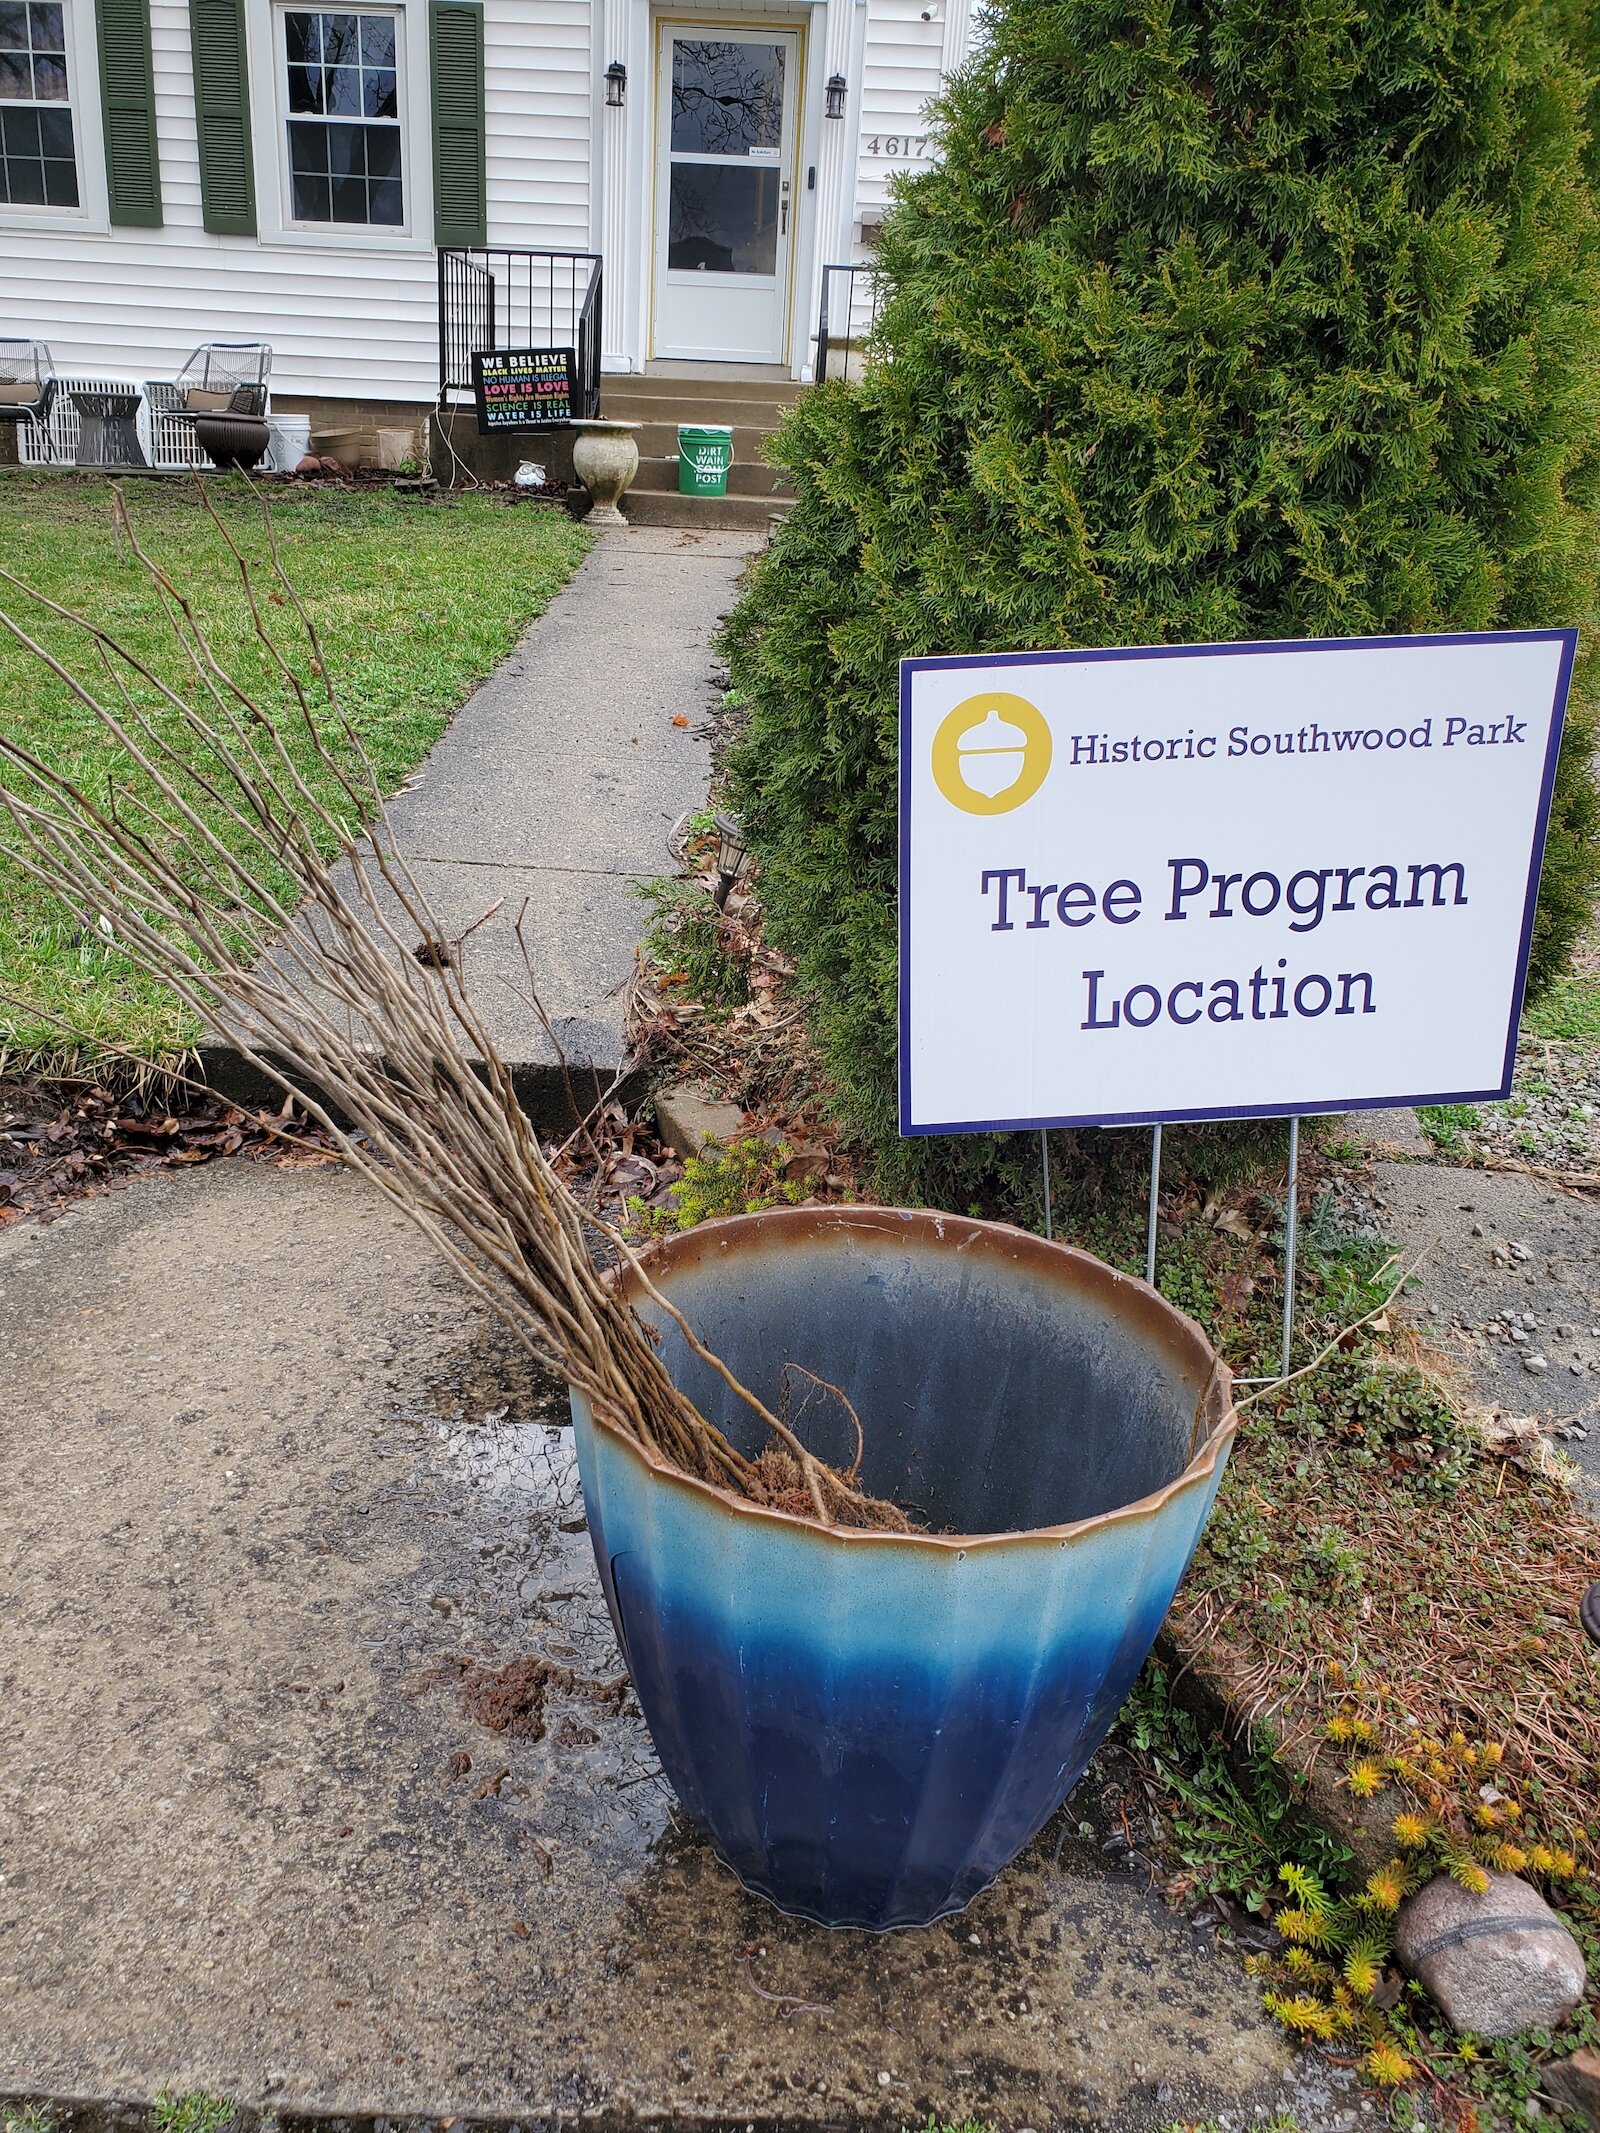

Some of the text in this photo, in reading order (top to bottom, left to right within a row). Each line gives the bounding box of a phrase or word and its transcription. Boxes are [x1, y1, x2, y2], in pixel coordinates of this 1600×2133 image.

[867, 136, 928, 156] 4617
[481, 354, 567, 369] WE BELIEVE
[482, 365, 567, 376] BLACK LIVES MATTER
[483, 373, 568, 384] NO HUMAN IS ILLEGAL
[484, 381, 569, 395] LOVE IS LOVE
[509, 394, 524, 402] Rights
[554, 391, 569, 399] Rights
[486, 400, 570, 412] SCIENCE IS REAL
[487, 408, 572, 420] WATER IS LIFE
[698, 446, 722, 456] DIRT
[695, 455, 724, 465] WAIN
[695, 473, 722, 484] POST
[1069, 714, 1528, 765] Historic Southwood Park
[980, 857, 1469, 933] Tree Program
[1080, 958, 1377, 1030] Location
